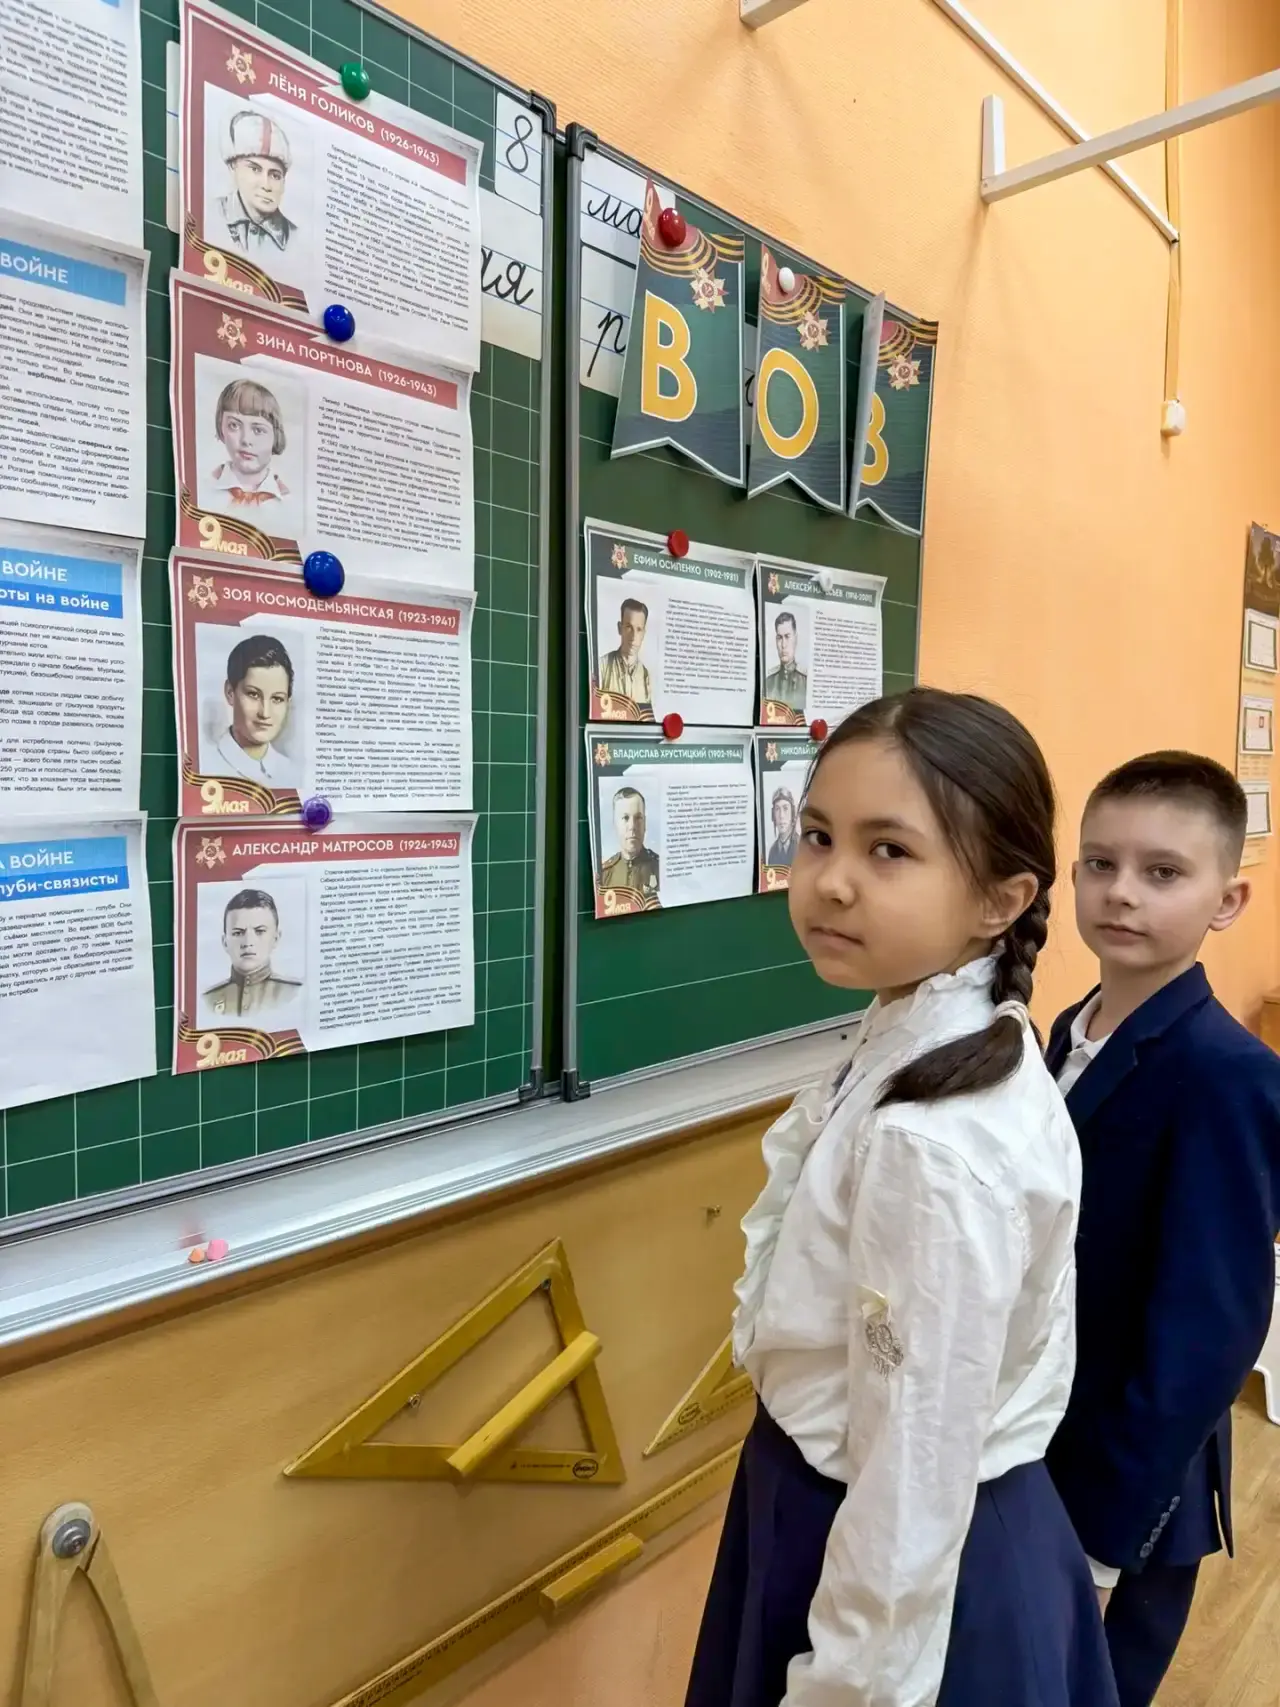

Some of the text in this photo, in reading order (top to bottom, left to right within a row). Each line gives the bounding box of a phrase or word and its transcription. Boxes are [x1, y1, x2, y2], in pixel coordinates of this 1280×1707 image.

[268, 72, 440, 166] ЛЁНЯ ГОЛИКОВ (1926-1943)
[506, 114, 533, 173] 8
[0, 252, 69, 284] ВОЙНЕ
[203, 249, 228, 284] 9
[256, 331, 437, 398] ЗИНА ПОРТНОВА (1926-1943)
[198, 515, 222, 550] 9
[2, 559, 69, 582] ВОЙНЕ
[634, 554, 739, 583] ЕФИМ ОСИПЕНКО (1902-1981)
[784, 579, 813, 593] АЛЕКСЕЙ
[35, 592, 56, 605] на
[60, 593, 110, 611] войне
[223, 587, 457, 629] ЗОЯ КОСМОДЕМЬЯНСКАЯ (1923-1941)
[600, 693, 613, 719] 9
[613, 748, 660, 759] ВЛАДИСЛАВ
[660, 747, 708, 759] ХРУСТИЦКИЙ
[201, 779, 225, 813] 9
[10, 849, 74, 869] ВОЙНЕ
[232, 838, 458, 857] АЛЕКСАНДР МАТРОСОВ (1924-1943)
[604, 889, 616, 915] 9
[196, 1032, 222, 1068] 9
